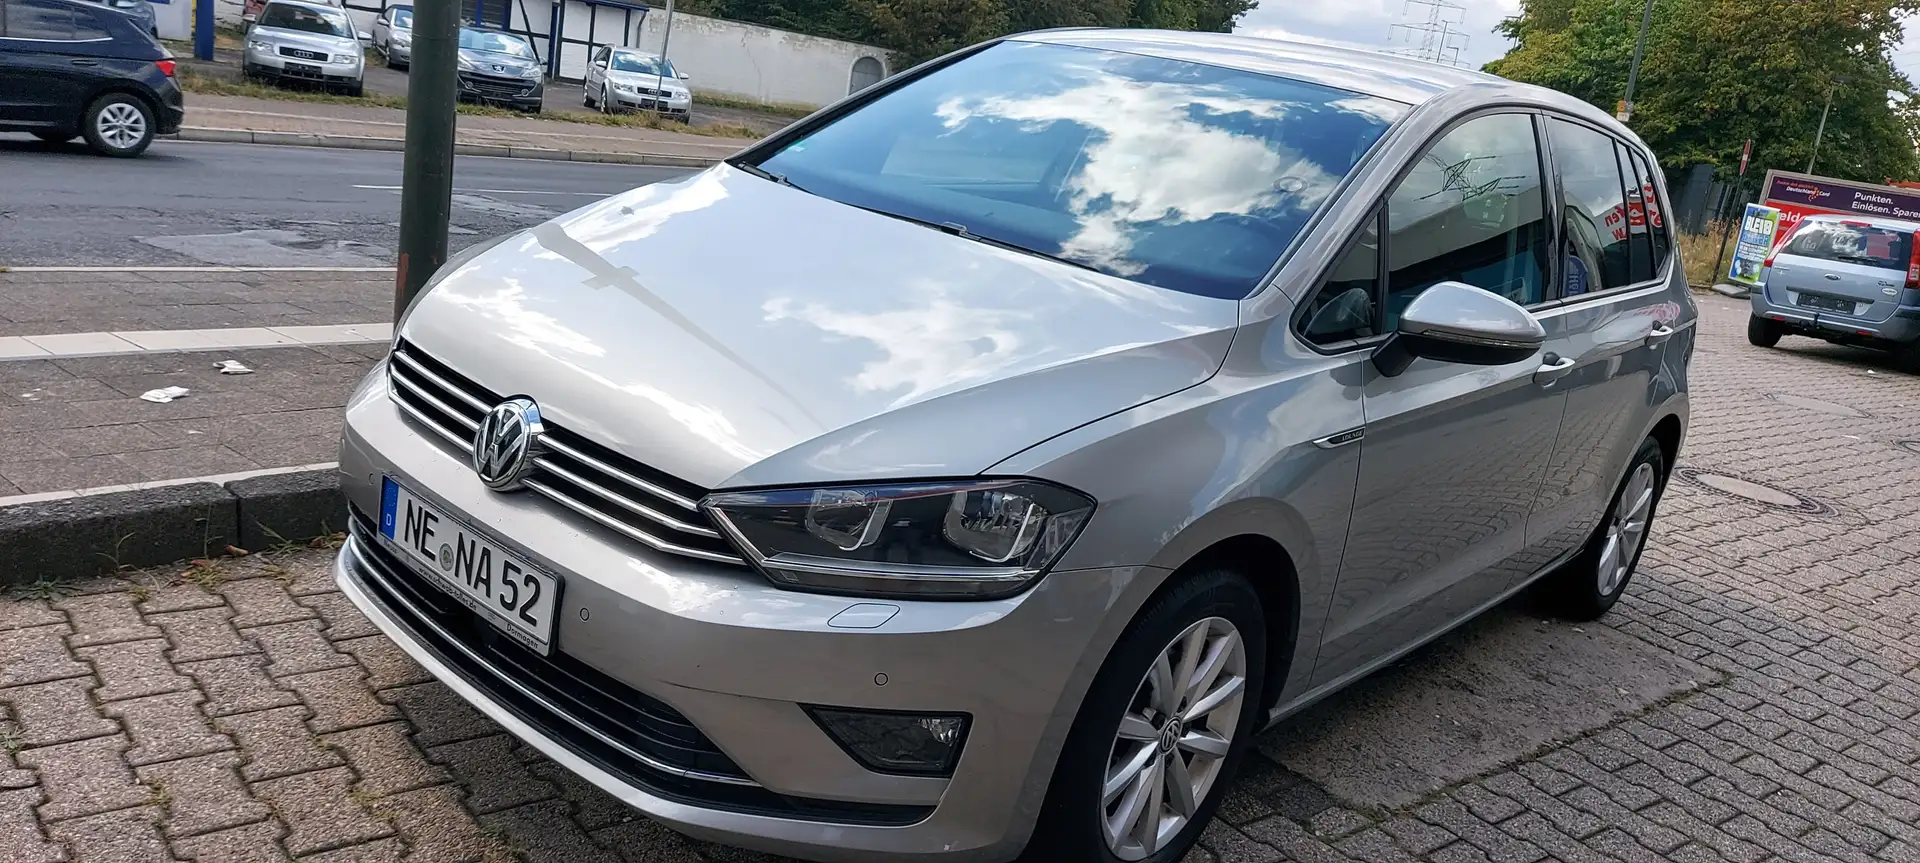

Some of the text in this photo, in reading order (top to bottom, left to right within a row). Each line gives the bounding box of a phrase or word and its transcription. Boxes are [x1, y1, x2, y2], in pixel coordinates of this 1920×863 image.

[1854, 192, 1893, 205] Punkten.
[1851, 201, 1890, 214] Einlösen.
[386, 513, 392, 526] D
[404, 498, 541, 627] NE NA 52
[506, 623, 539, 649] Dormagen
